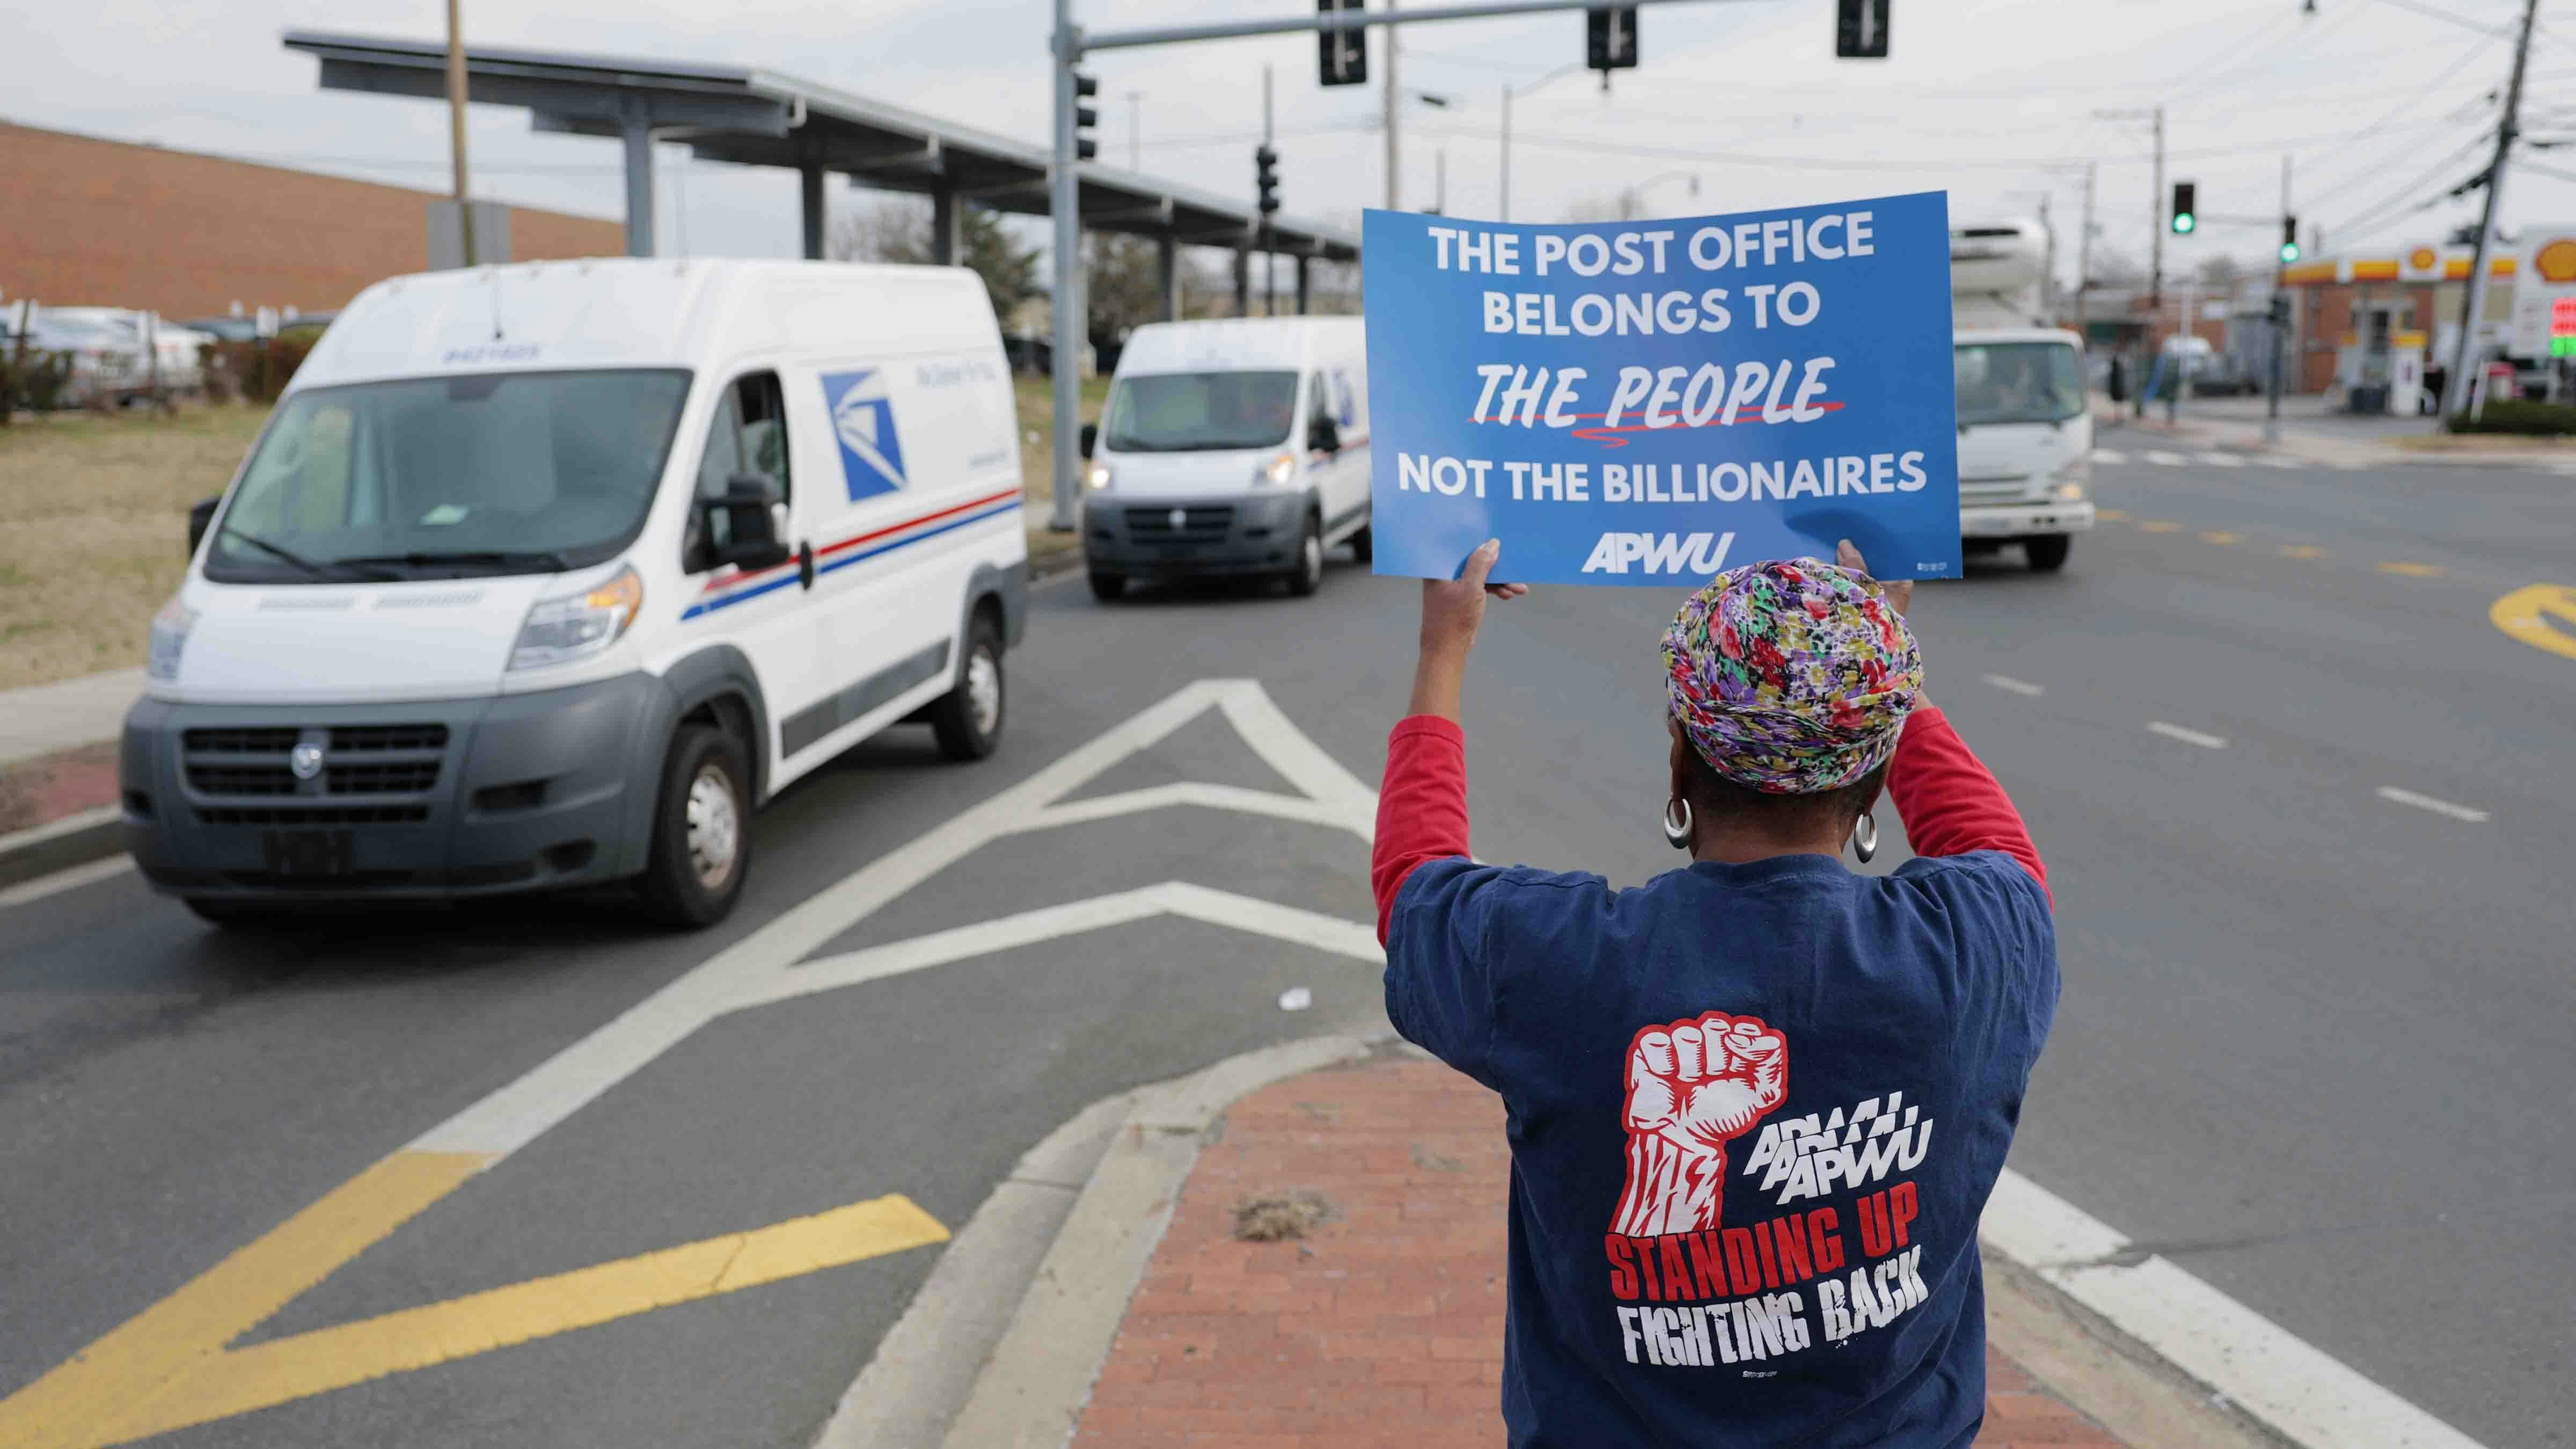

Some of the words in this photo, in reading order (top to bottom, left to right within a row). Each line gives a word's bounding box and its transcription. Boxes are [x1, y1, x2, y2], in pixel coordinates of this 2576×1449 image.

[1428, 226, 1520, 275] THE
[1535, 230, 1674, 276] POST
[1689, 211, 1874, 271] OFFICE
[1483, 289, 1731, 336] BELONGS
[1745, 281, 1821, 328] TO
[1473, 363, 1587, 428] THE
[1605, 356, 1836, 429] PEOPLE
[1398, 453, 1492, 497] NOT
[1504, 462, 1589, 501] THE
[1603, 451, 1927, 502] BILLIONAIRES
[1582, 532, 1734, 575] APWU
[1776, 1118, 1934, 1205] APWU
[1605, 1208, 1845, 1301] STANDING
[1857, 1181, 1919, 1257] UP
[1616, 1292, 1811, 1366] FIGHTING
[1817, 1244, 1929, 1343] BACK
